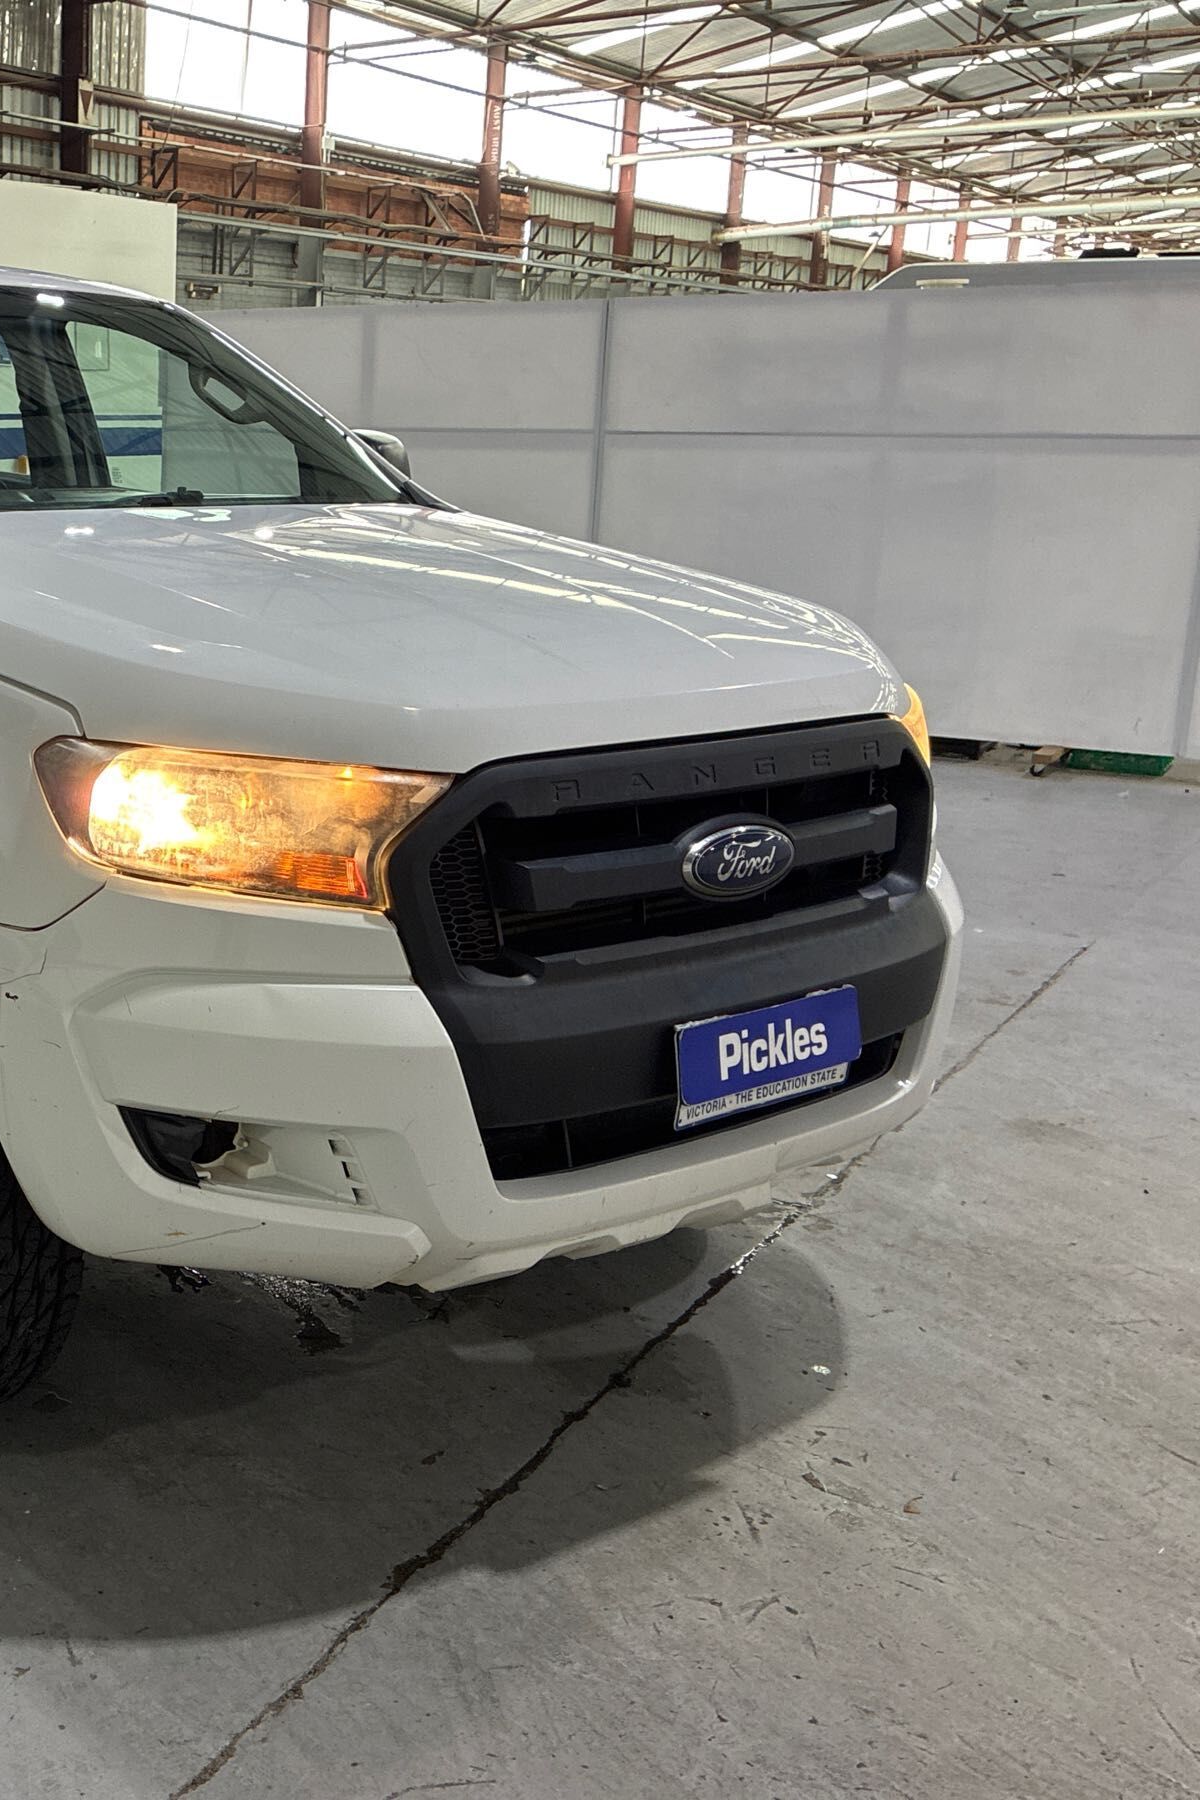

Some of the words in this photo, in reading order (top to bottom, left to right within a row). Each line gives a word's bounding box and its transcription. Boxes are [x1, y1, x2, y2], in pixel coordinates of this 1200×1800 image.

[552, 739, 880, 801] RANGER
[717, 839, 777, 881] Ford
[718, 1018, 828, 1081] Pickles
[686, 1098, 727, 1119] VICTORIA
[735, 1090, 753, 1105] THE
[756, 1076, 808, 1099] EDUCATION
[810, 1068, 836, 1085] STATE
